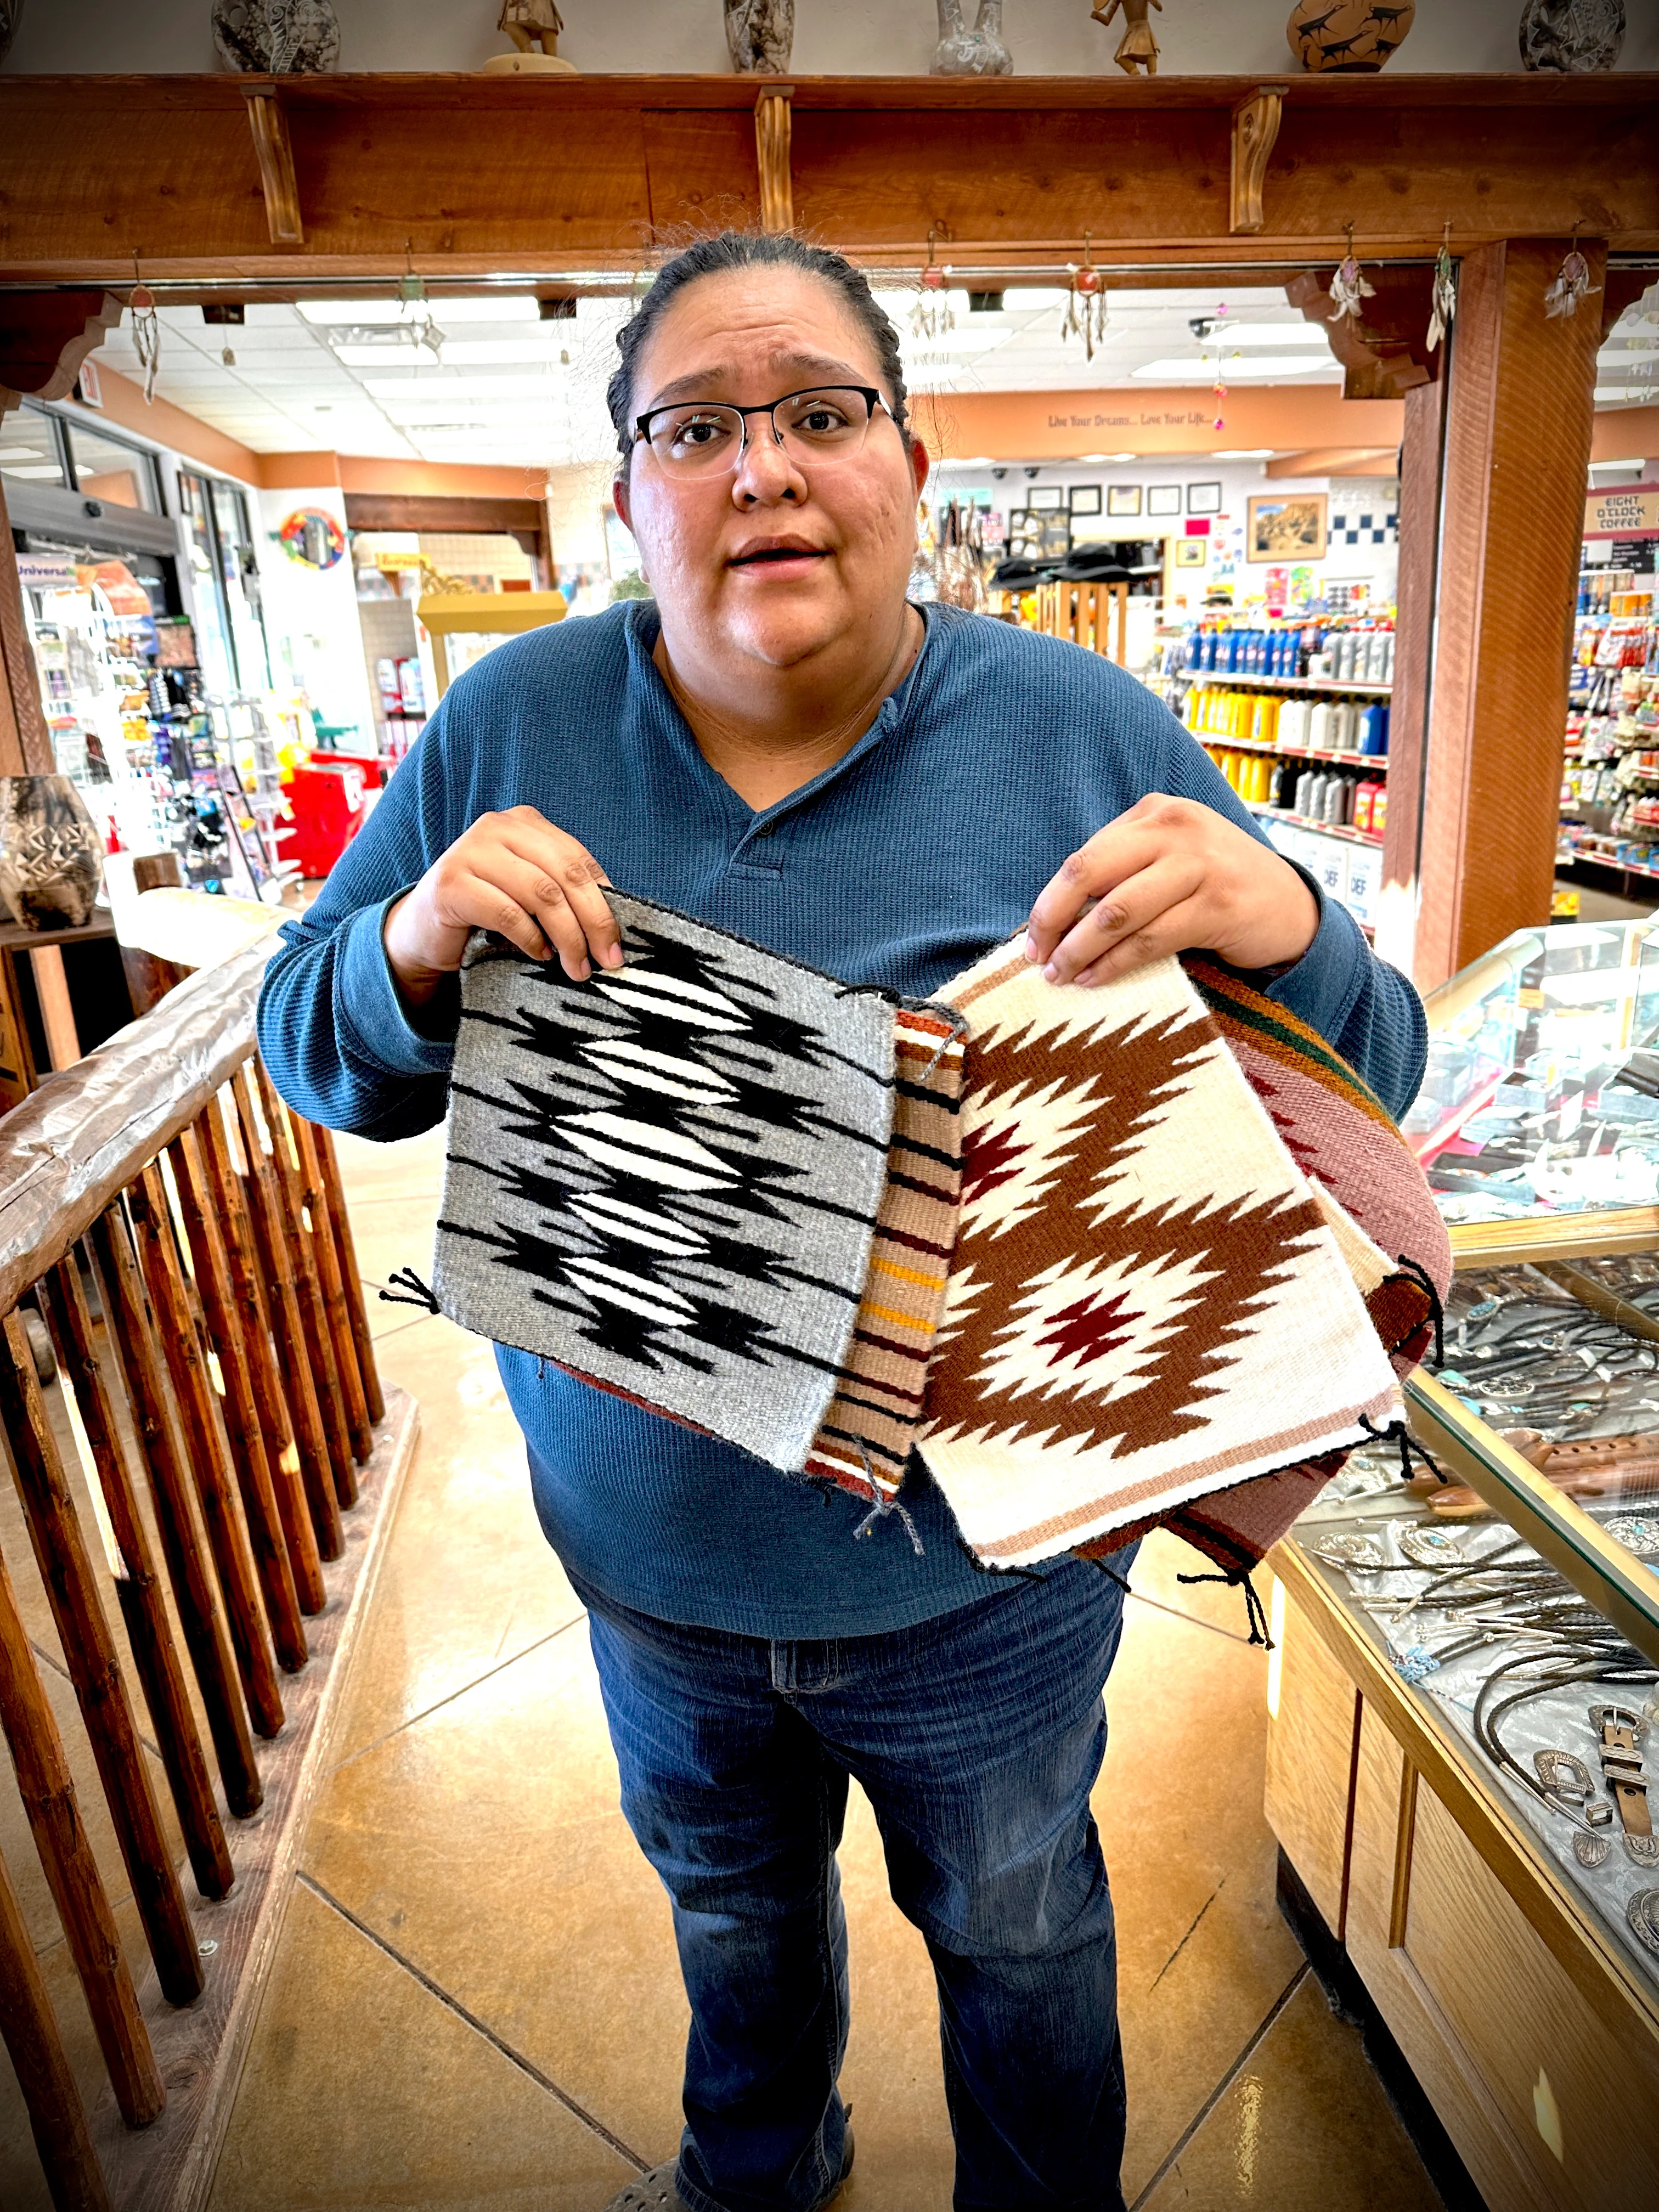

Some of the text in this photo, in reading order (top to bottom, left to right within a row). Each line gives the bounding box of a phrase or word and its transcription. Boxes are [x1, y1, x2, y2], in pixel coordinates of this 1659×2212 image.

[1048, 414, 1067, 427] Live
[1070, 414, 1092, 426] Your
[1141, 413, 1161, 425] Love
[1164, 413, 1185, 424] Your
[1606, 496, 1639, 506] EIGHT
[1597, 506, 1645, 518] O'CLOCK
[1600, 517, 1641, 529] COFFEE
